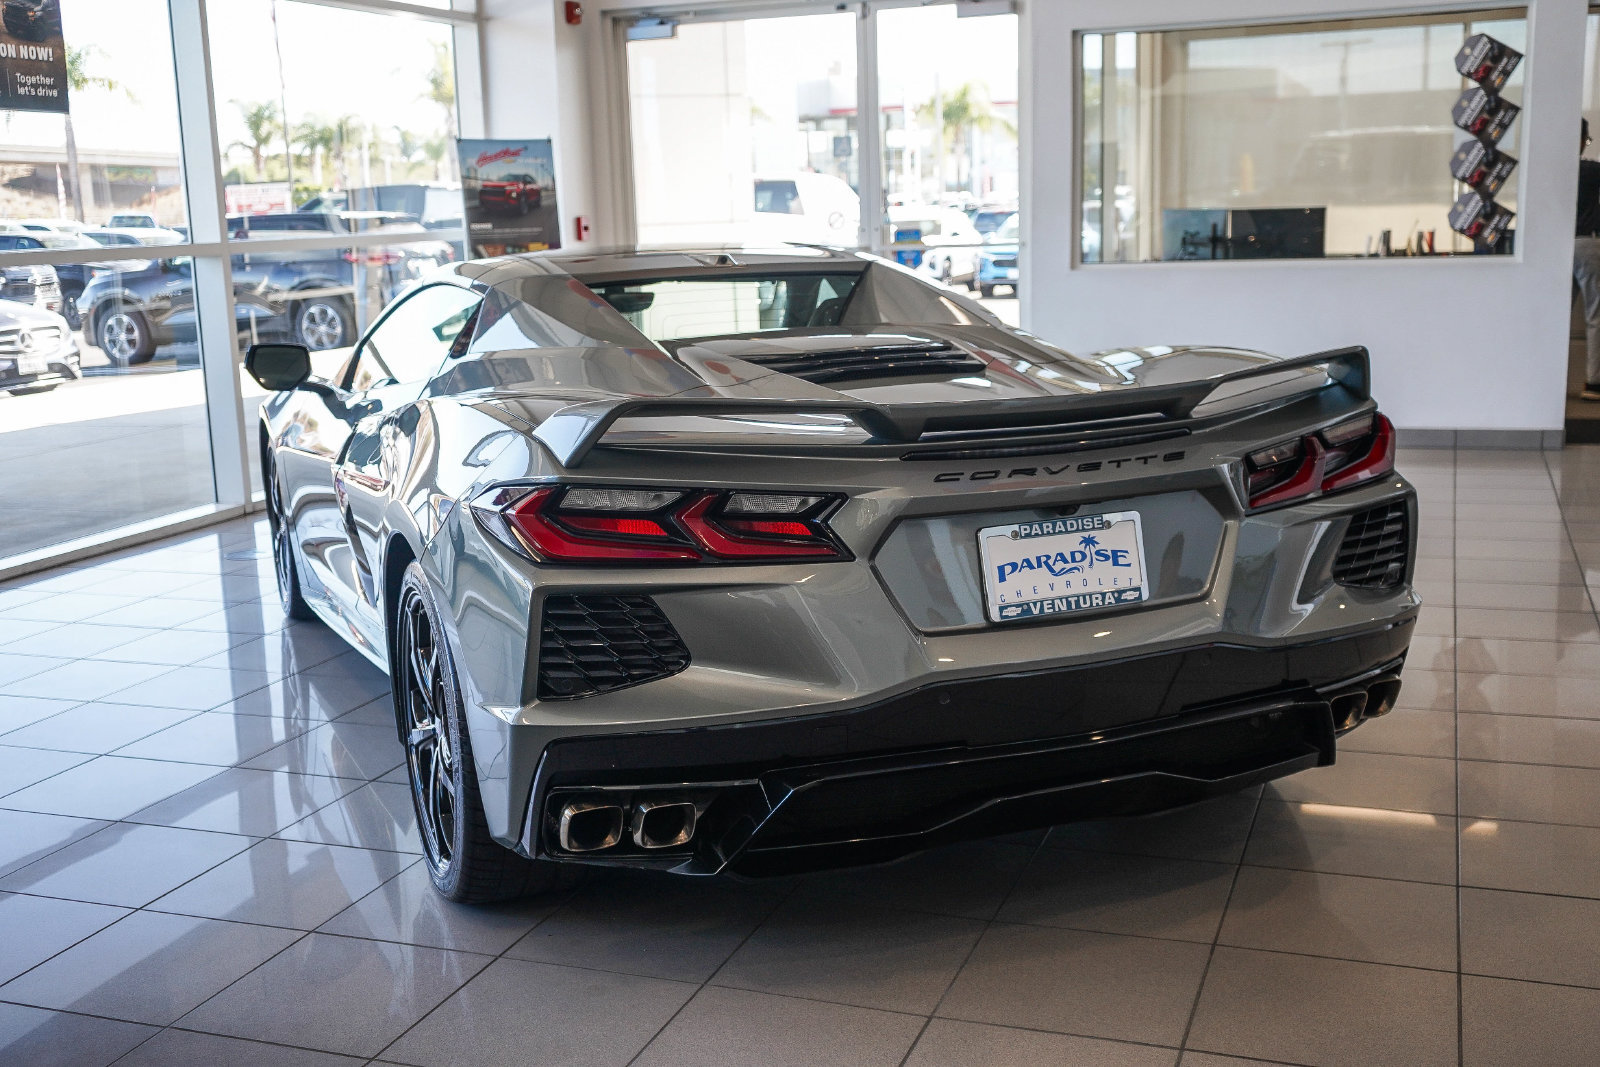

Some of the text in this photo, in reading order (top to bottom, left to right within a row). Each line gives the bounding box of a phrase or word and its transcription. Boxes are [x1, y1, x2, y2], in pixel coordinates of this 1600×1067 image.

[20, 45, 53, 61] NOW!
[15, 72, 54, 86] Together
[17, 85, 58, 97] let's drive
[933, 450, 1186, 483] CORVETTE
[1020, 516, 1104, 537] PARADISE
[997, 540, 1131, 583] PARADISE
[1000, 577, 1133, 603] CHEVROLET
[1029, 593, 1116, 614] VENTURA
